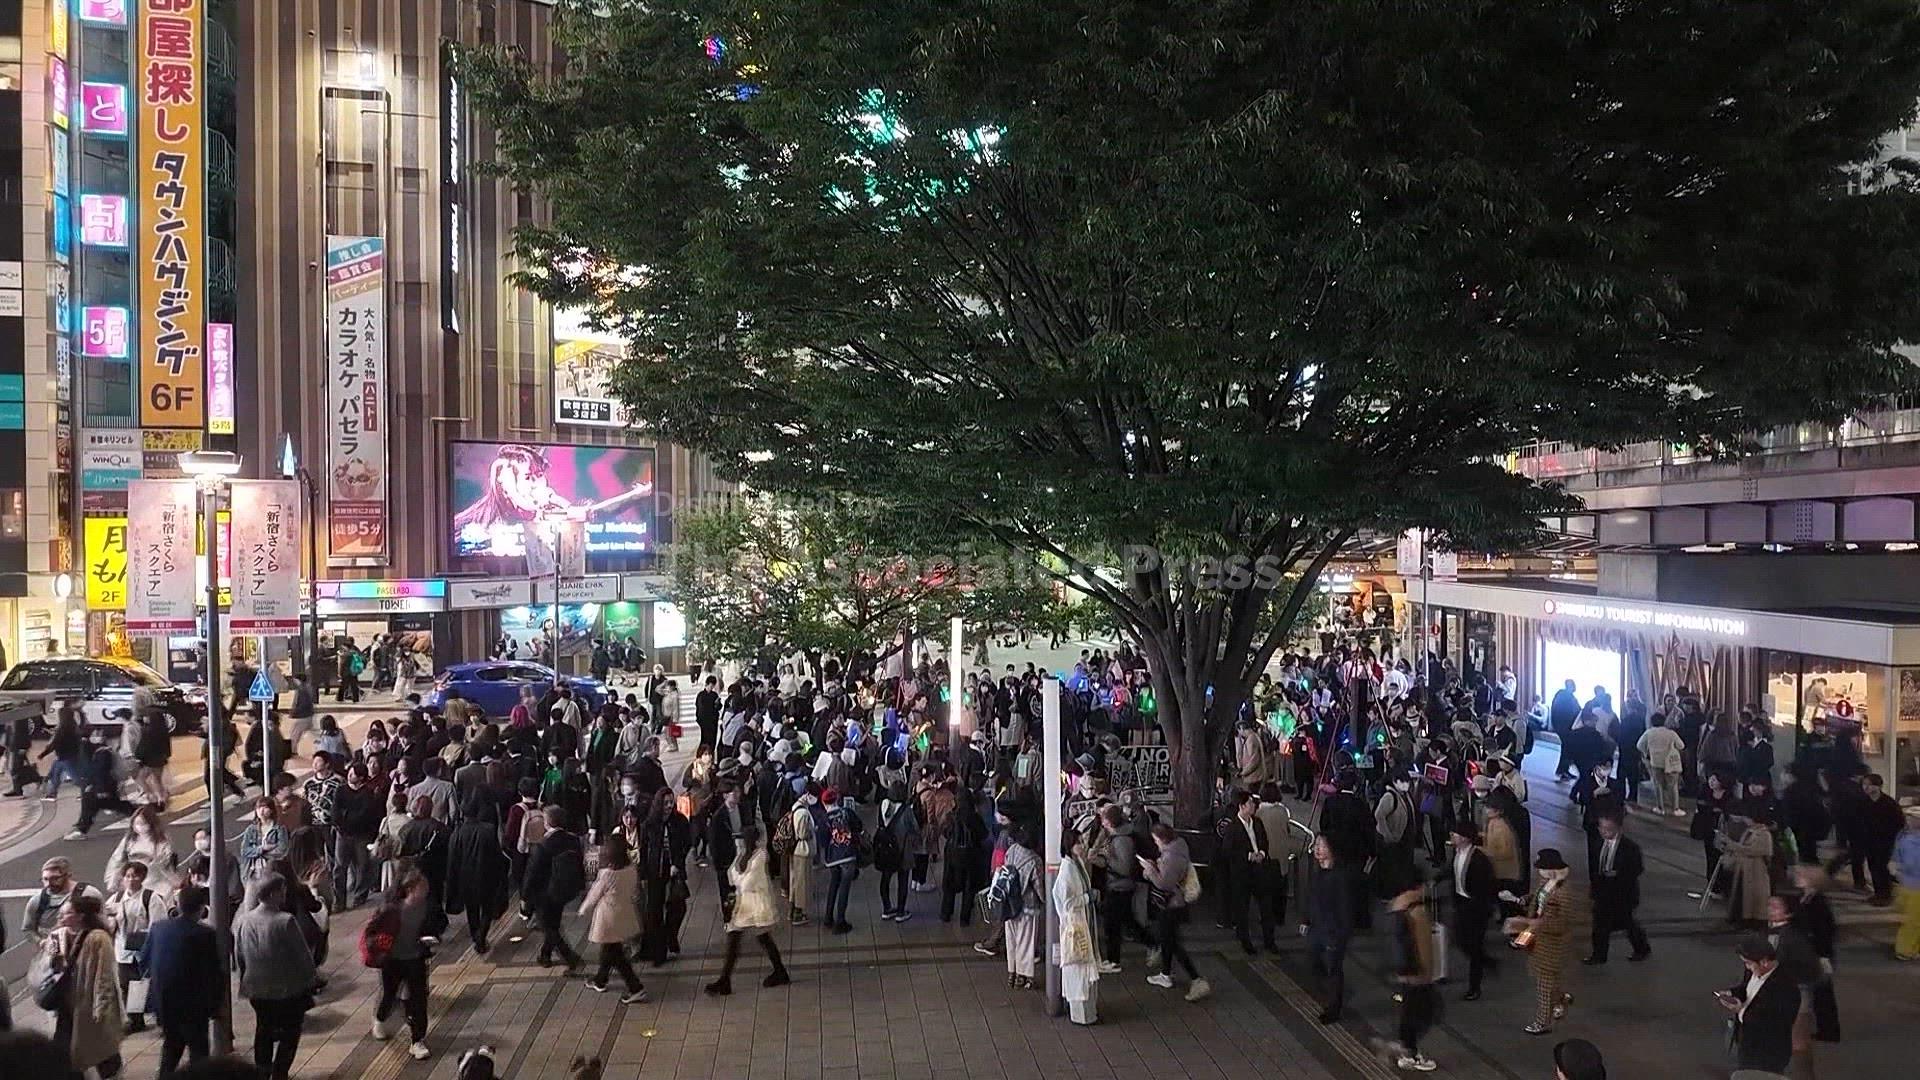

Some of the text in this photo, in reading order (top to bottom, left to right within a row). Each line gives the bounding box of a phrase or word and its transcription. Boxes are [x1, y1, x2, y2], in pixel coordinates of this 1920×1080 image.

[91, 95, 116, 121] と
[154, 152, 198, 375] タウンハウジング
[90, 320, 122, 345] 5F
[339, 307, 361, 455] カラオケ パセラ
[151, 383, 194, 411] 6F
[364, 385, 377, 429] ハニトー
[267, 504, 281, 572] 「新宿さくら
[250, 544, 266, 595] スクエア」
[101, 591, 121, 602] 2F
[1606, 606, 1653, 624] TOURIST
[1655, 612, 1744, 635] INFORMATION
[1140, 748, 1170, 763] NO
